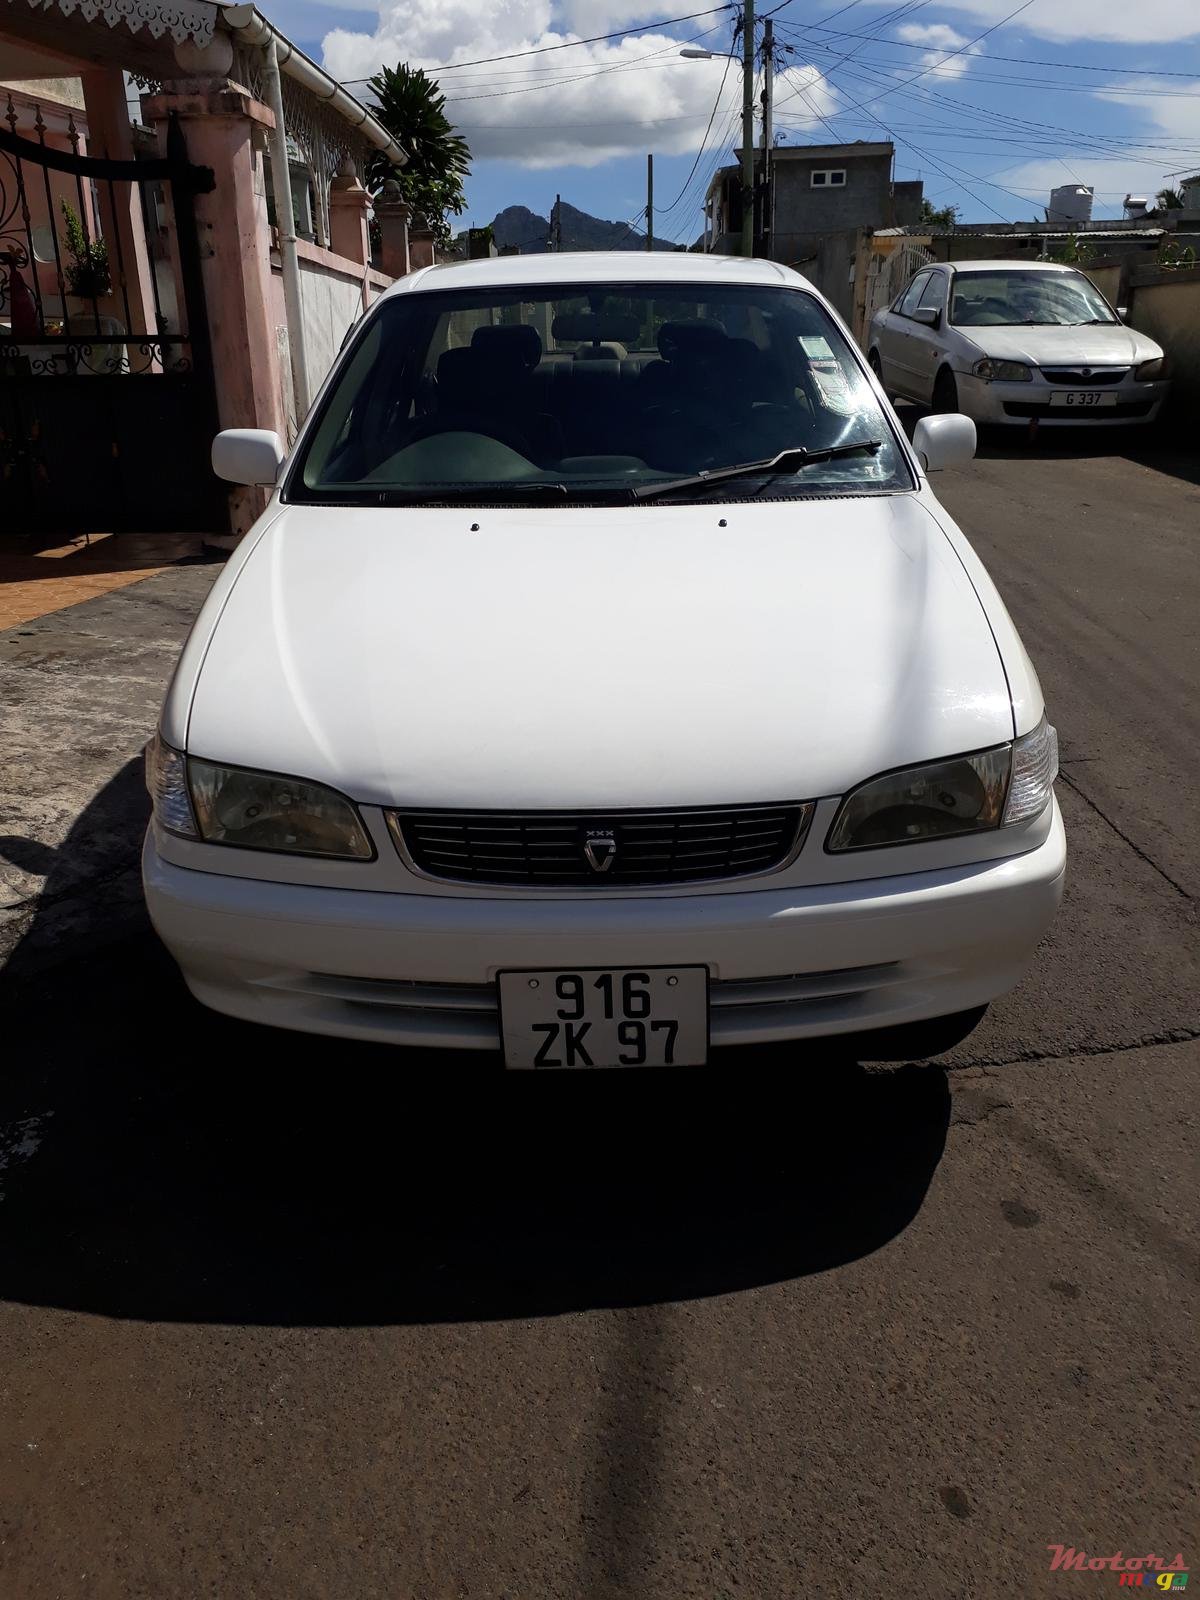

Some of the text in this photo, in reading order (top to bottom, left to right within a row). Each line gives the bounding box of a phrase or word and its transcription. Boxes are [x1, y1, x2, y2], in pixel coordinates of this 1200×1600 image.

[1066, 393, 1101, 405] G 337
[555, 972, 651, 1020] 916
[531, 1020, 679, 1067] ZK 97
